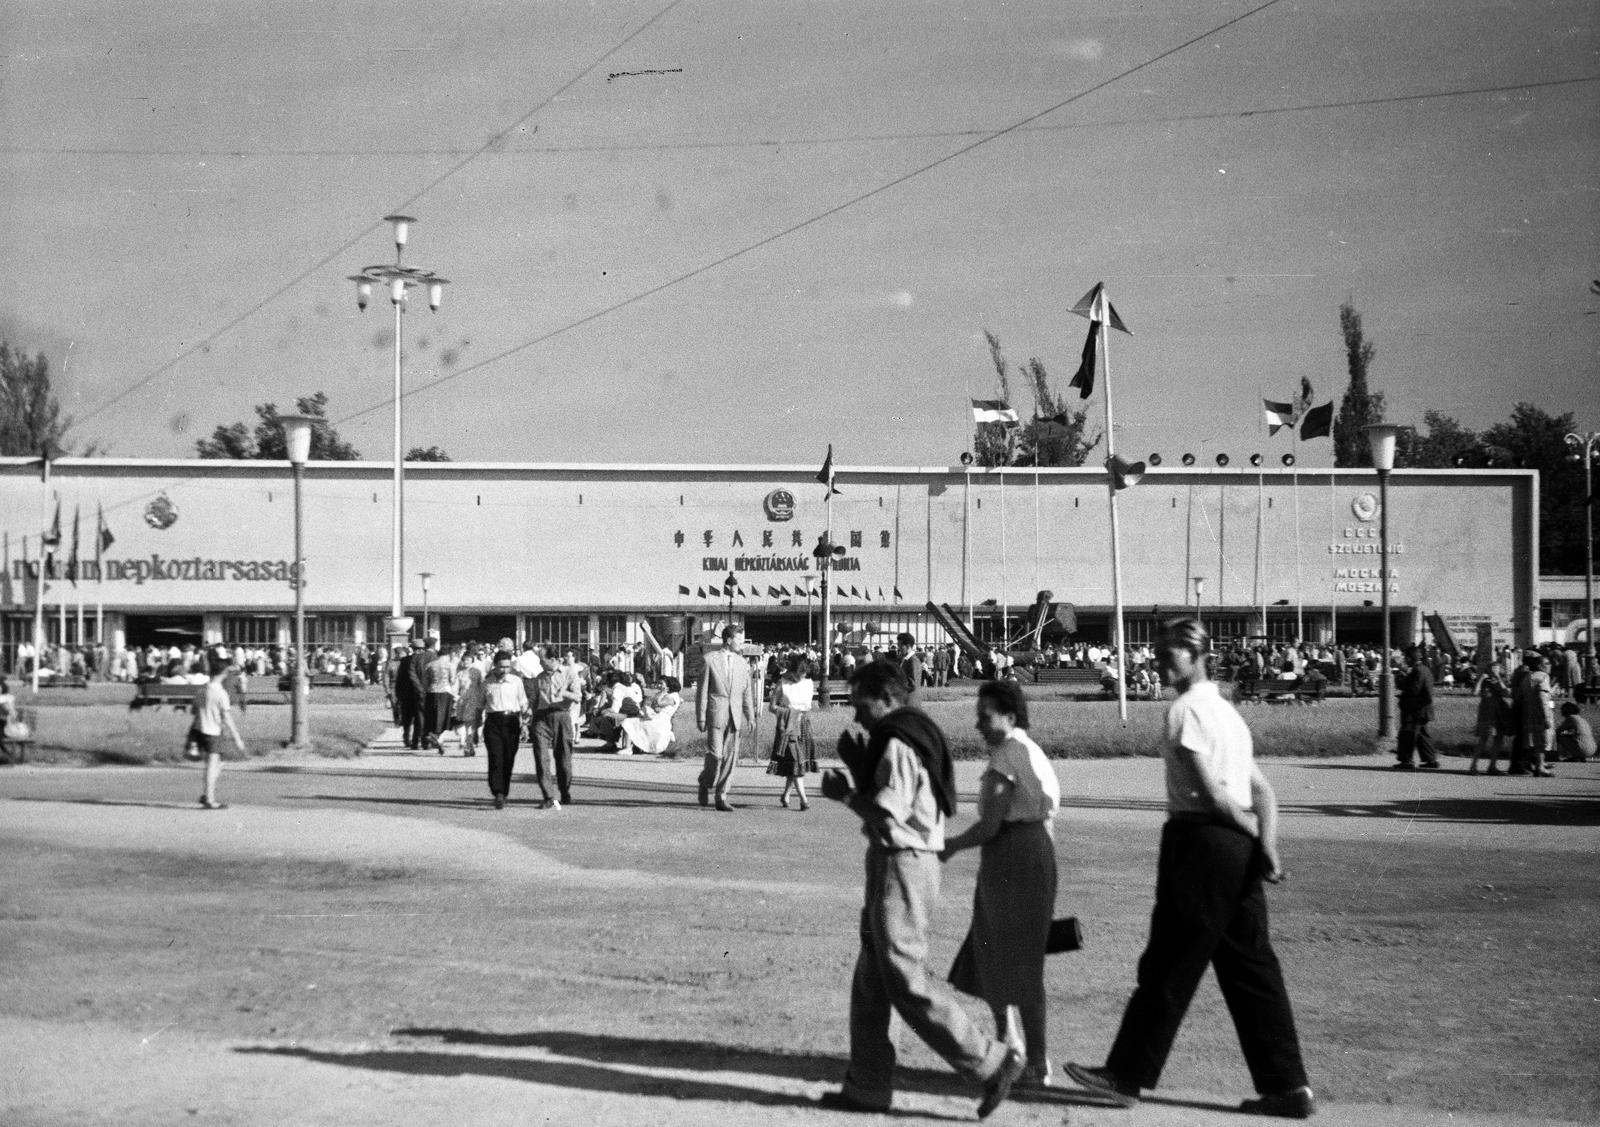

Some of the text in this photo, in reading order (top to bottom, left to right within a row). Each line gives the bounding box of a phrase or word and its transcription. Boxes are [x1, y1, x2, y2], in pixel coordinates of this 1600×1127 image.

[1343, 528, 1386, 538] ССС
[1333, 568, 1400, 578] МОСКА
[1334, 582, 1400, 593] MOSZKA
